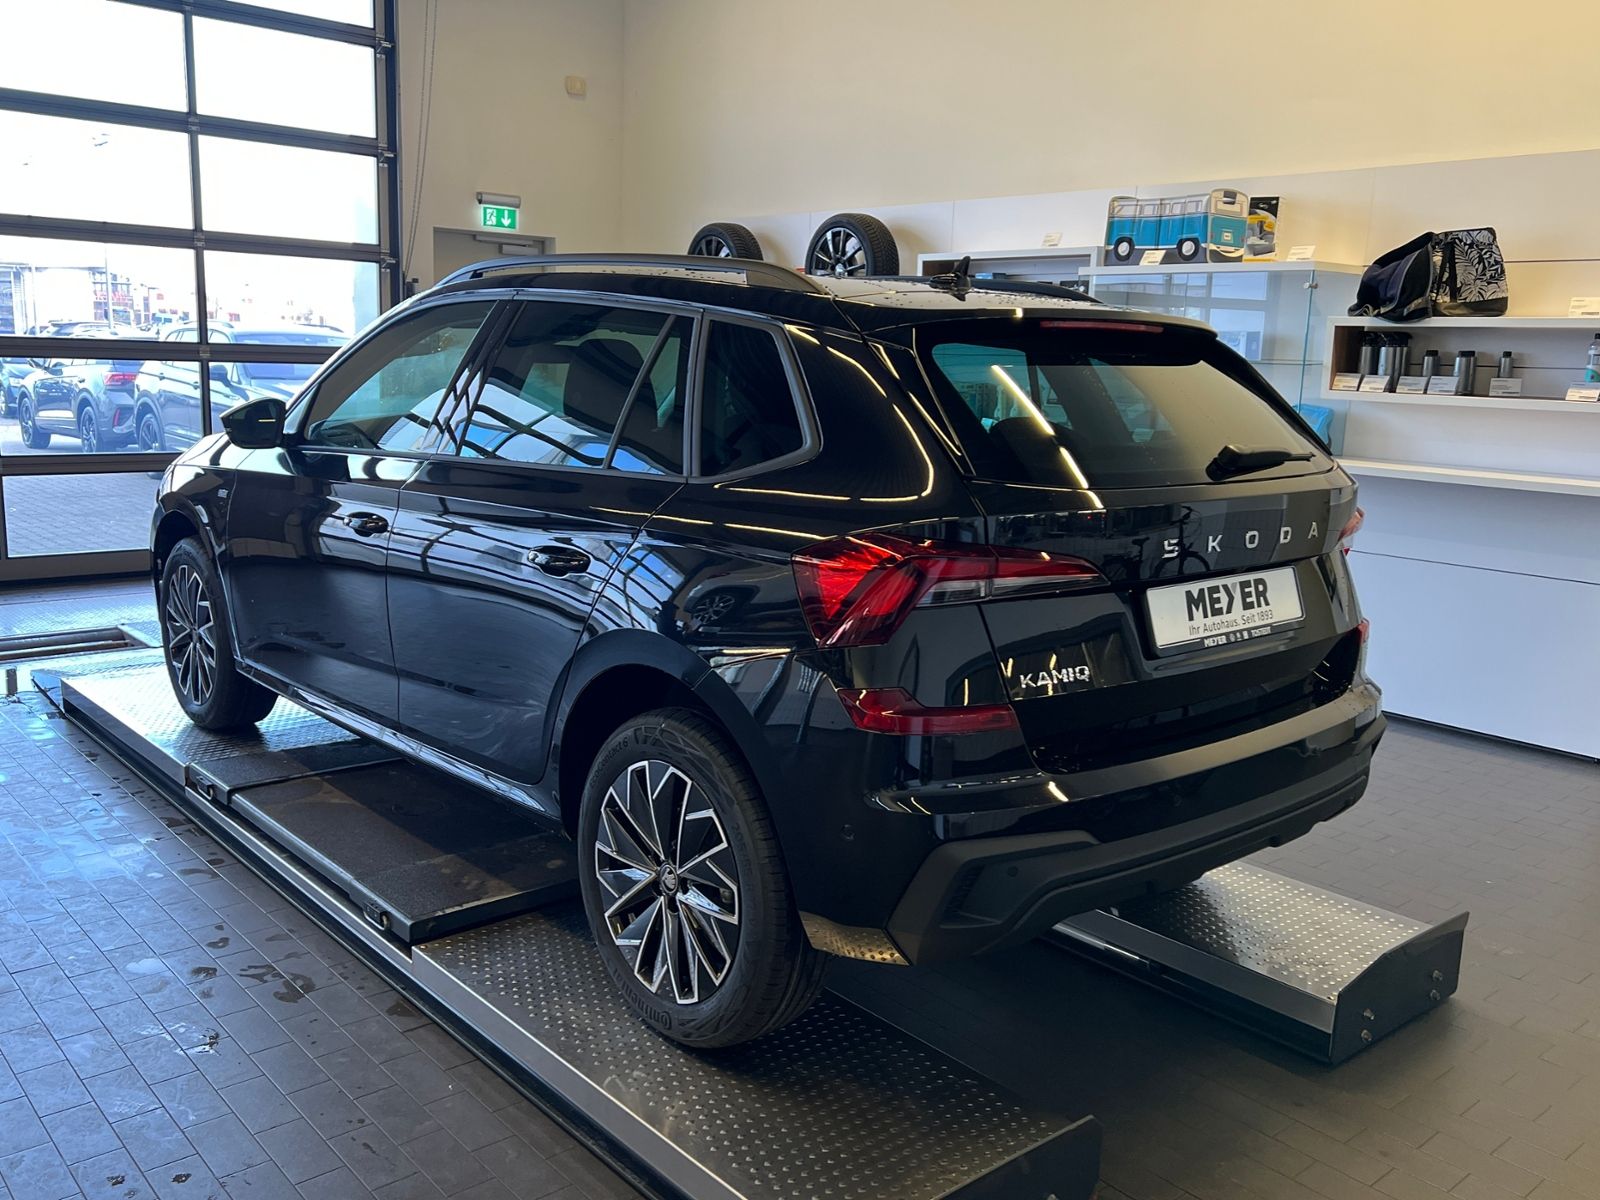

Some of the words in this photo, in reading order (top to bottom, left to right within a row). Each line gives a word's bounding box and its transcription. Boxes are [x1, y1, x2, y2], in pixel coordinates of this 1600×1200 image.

[1185, 577, 1271, 622] MEYER
[1188, 625, 1200, 636] Ihr
[1203, 618, 1240, 632] Autohaus.
[1241, 613, 1256, 625] Seit
[1257, 609, 1273, 622] 1893
[1020, 665, 1090, 688] KAMIQ
